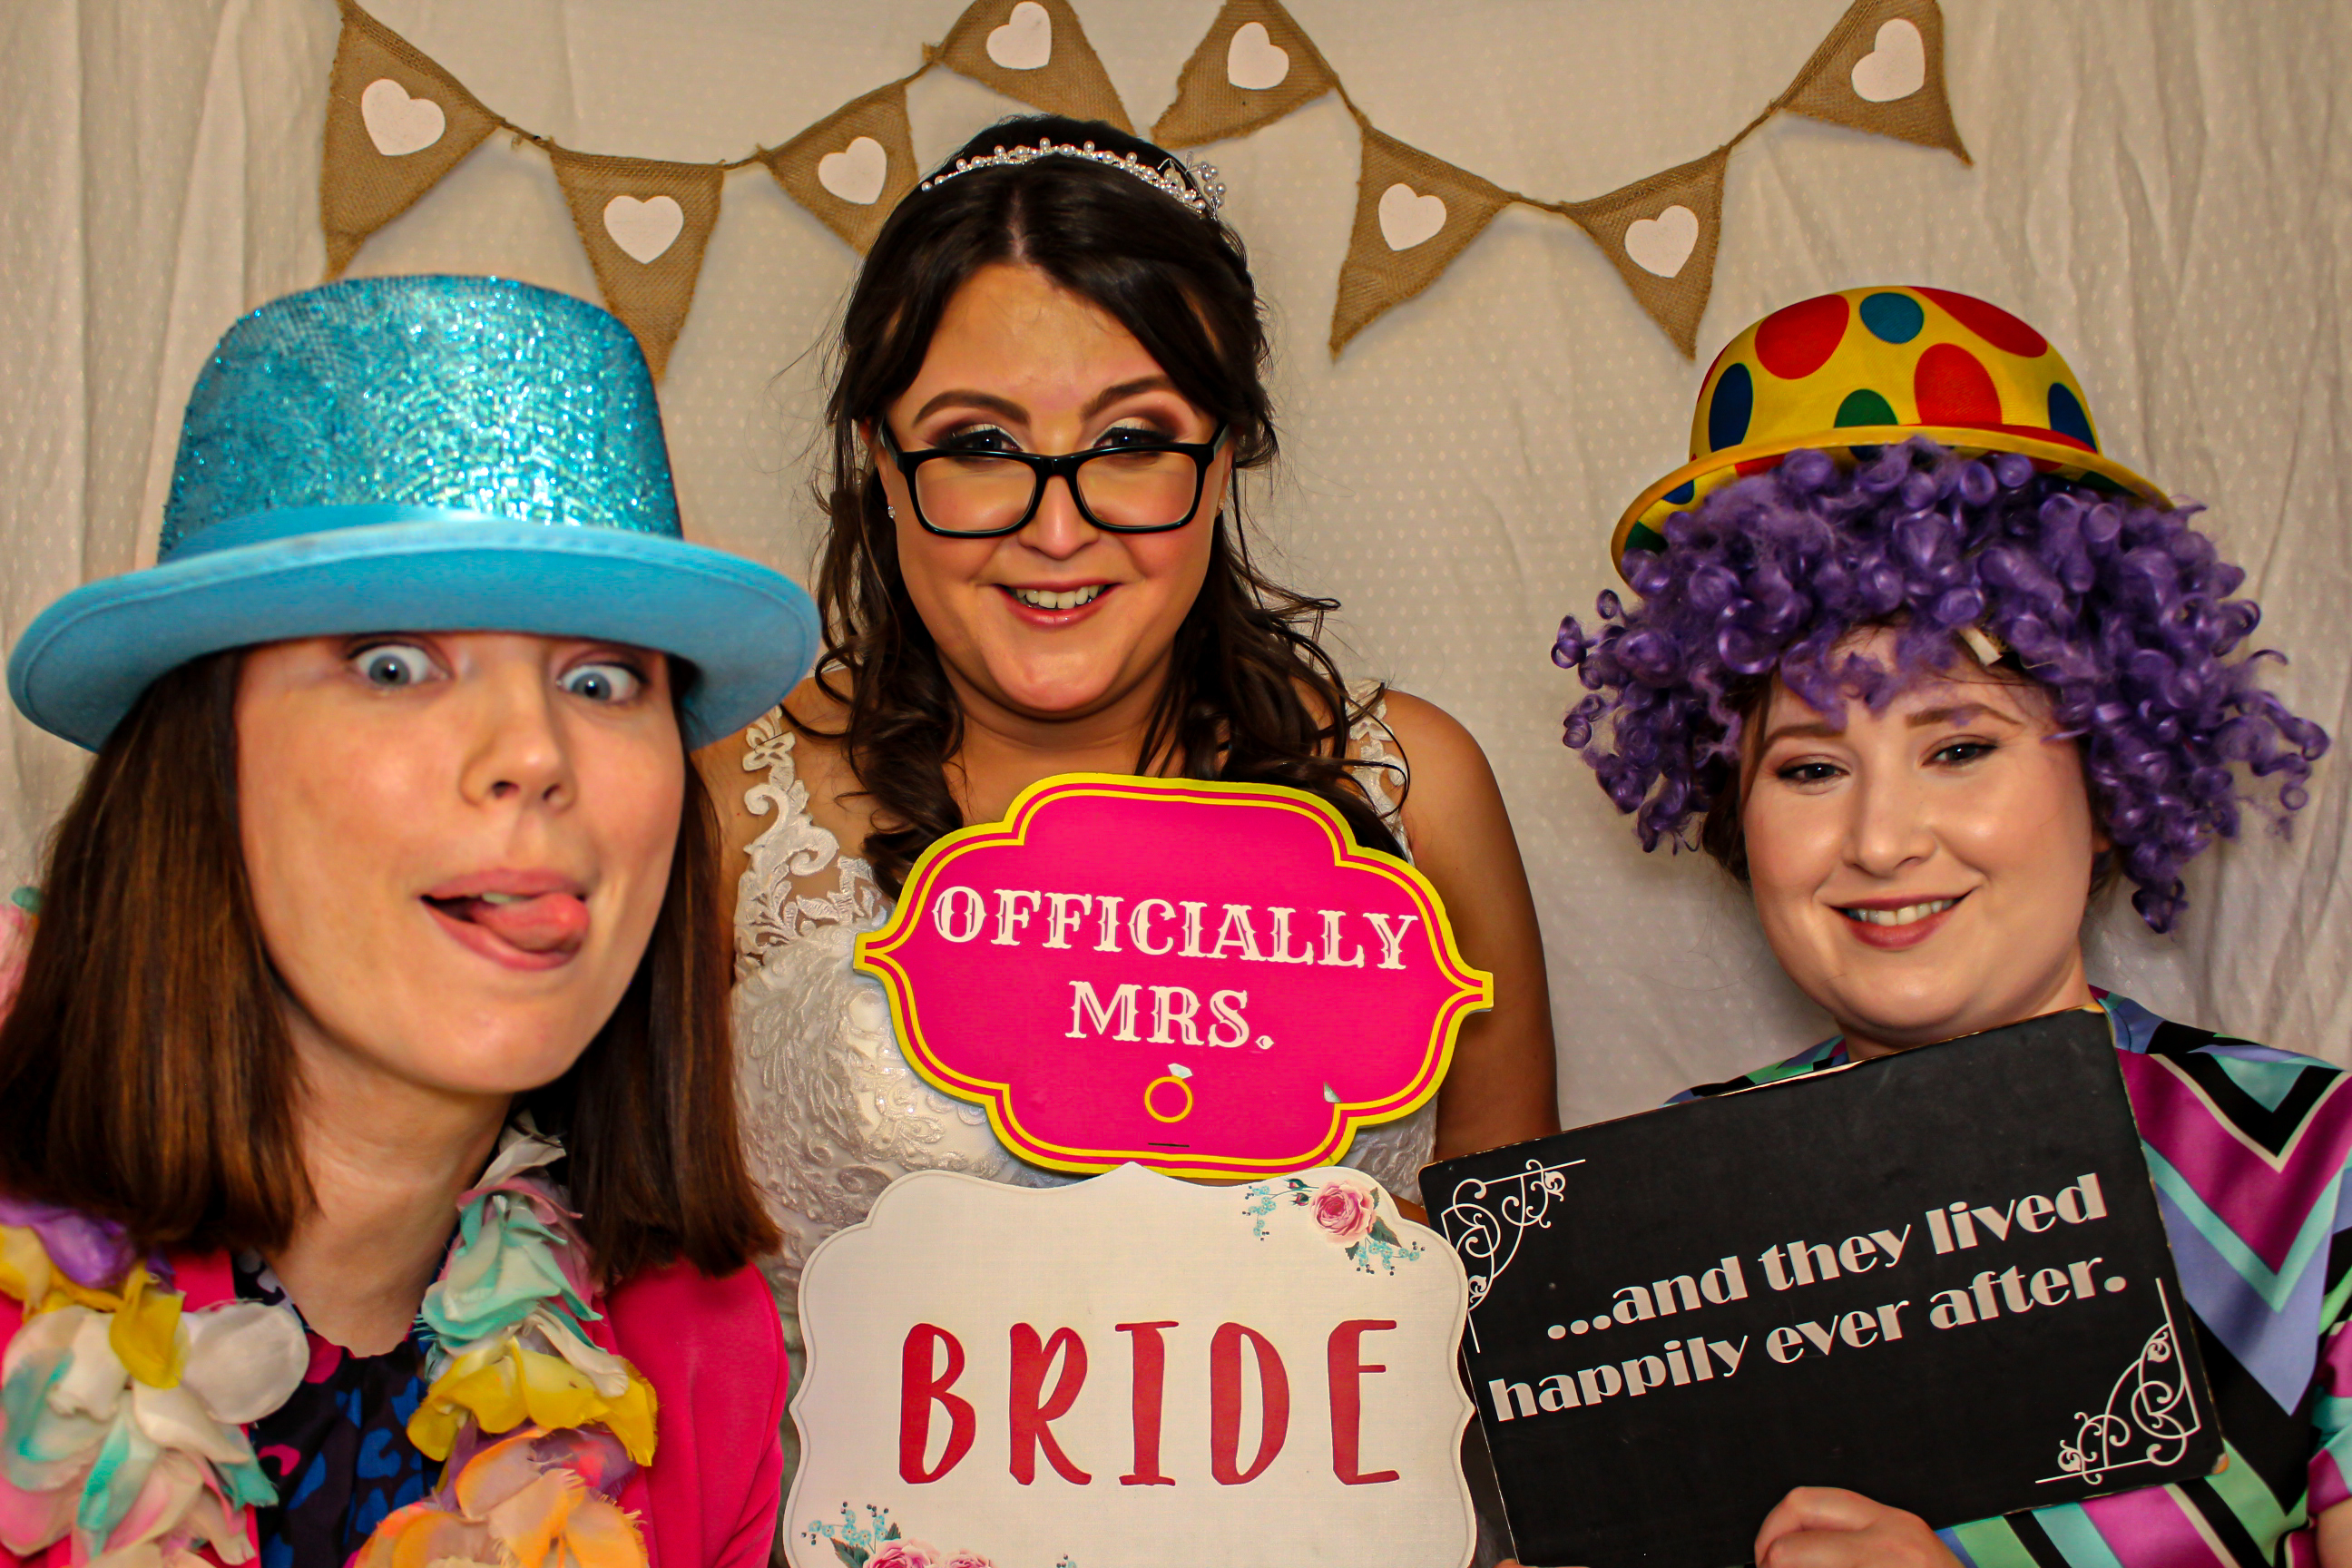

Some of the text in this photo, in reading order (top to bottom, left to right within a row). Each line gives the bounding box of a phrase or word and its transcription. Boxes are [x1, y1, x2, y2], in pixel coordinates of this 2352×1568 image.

[931, 886, 1419, 970] OFFICIALLY
[1064, 980, 1275, 1050] MRS.
[1547, 1172, 2107, 1339] ...and they lived
[898, 1318, 1400, 1486] BRIDE
[1488, 1257, 2126, 1422] happily ever after.
